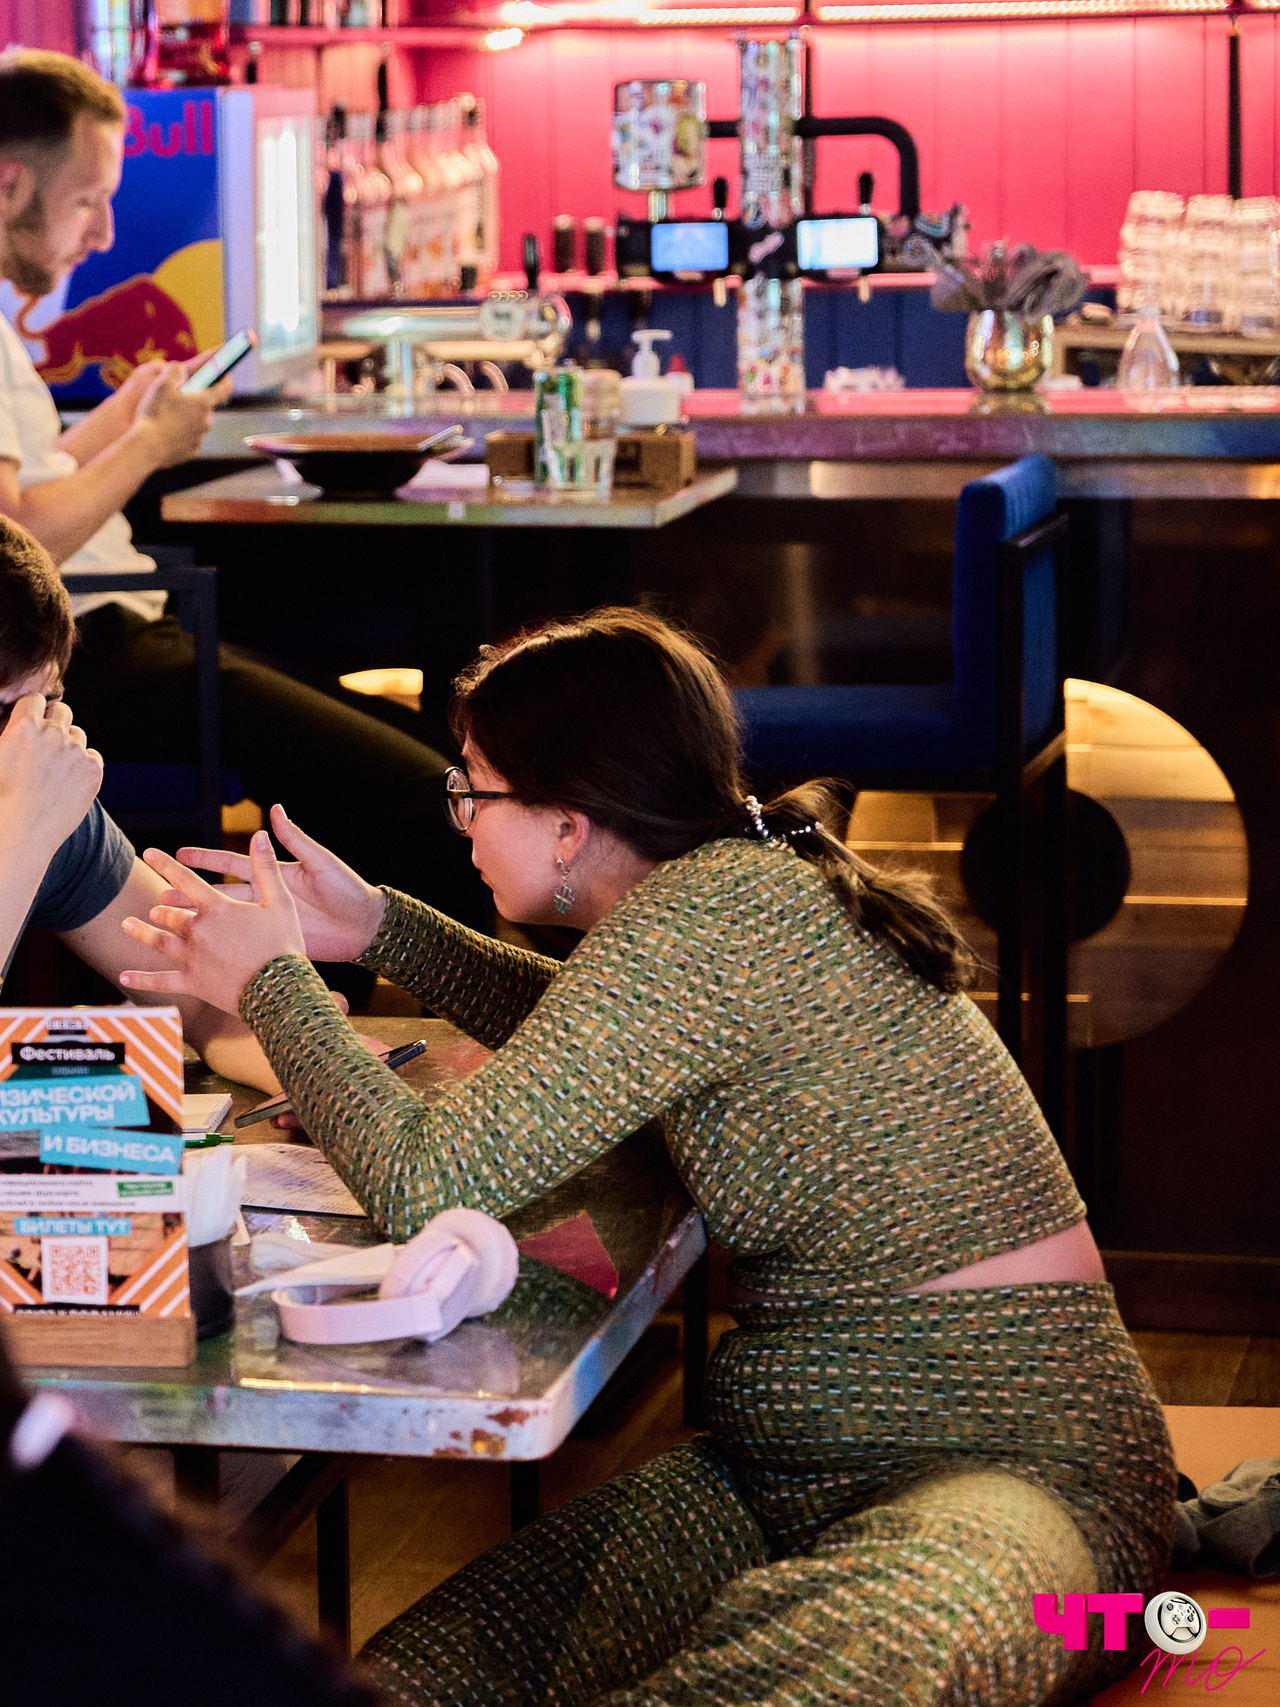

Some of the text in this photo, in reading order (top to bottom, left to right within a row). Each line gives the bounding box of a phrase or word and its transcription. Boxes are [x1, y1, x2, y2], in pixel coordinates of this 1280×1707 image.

[19, 1046, 115, 1061] Фестиваль
[44, 1135, 175, 1163] И БИЗНЕСА
[19, 1219, 130, 1235] БИЛЕТЫ ТУТ
